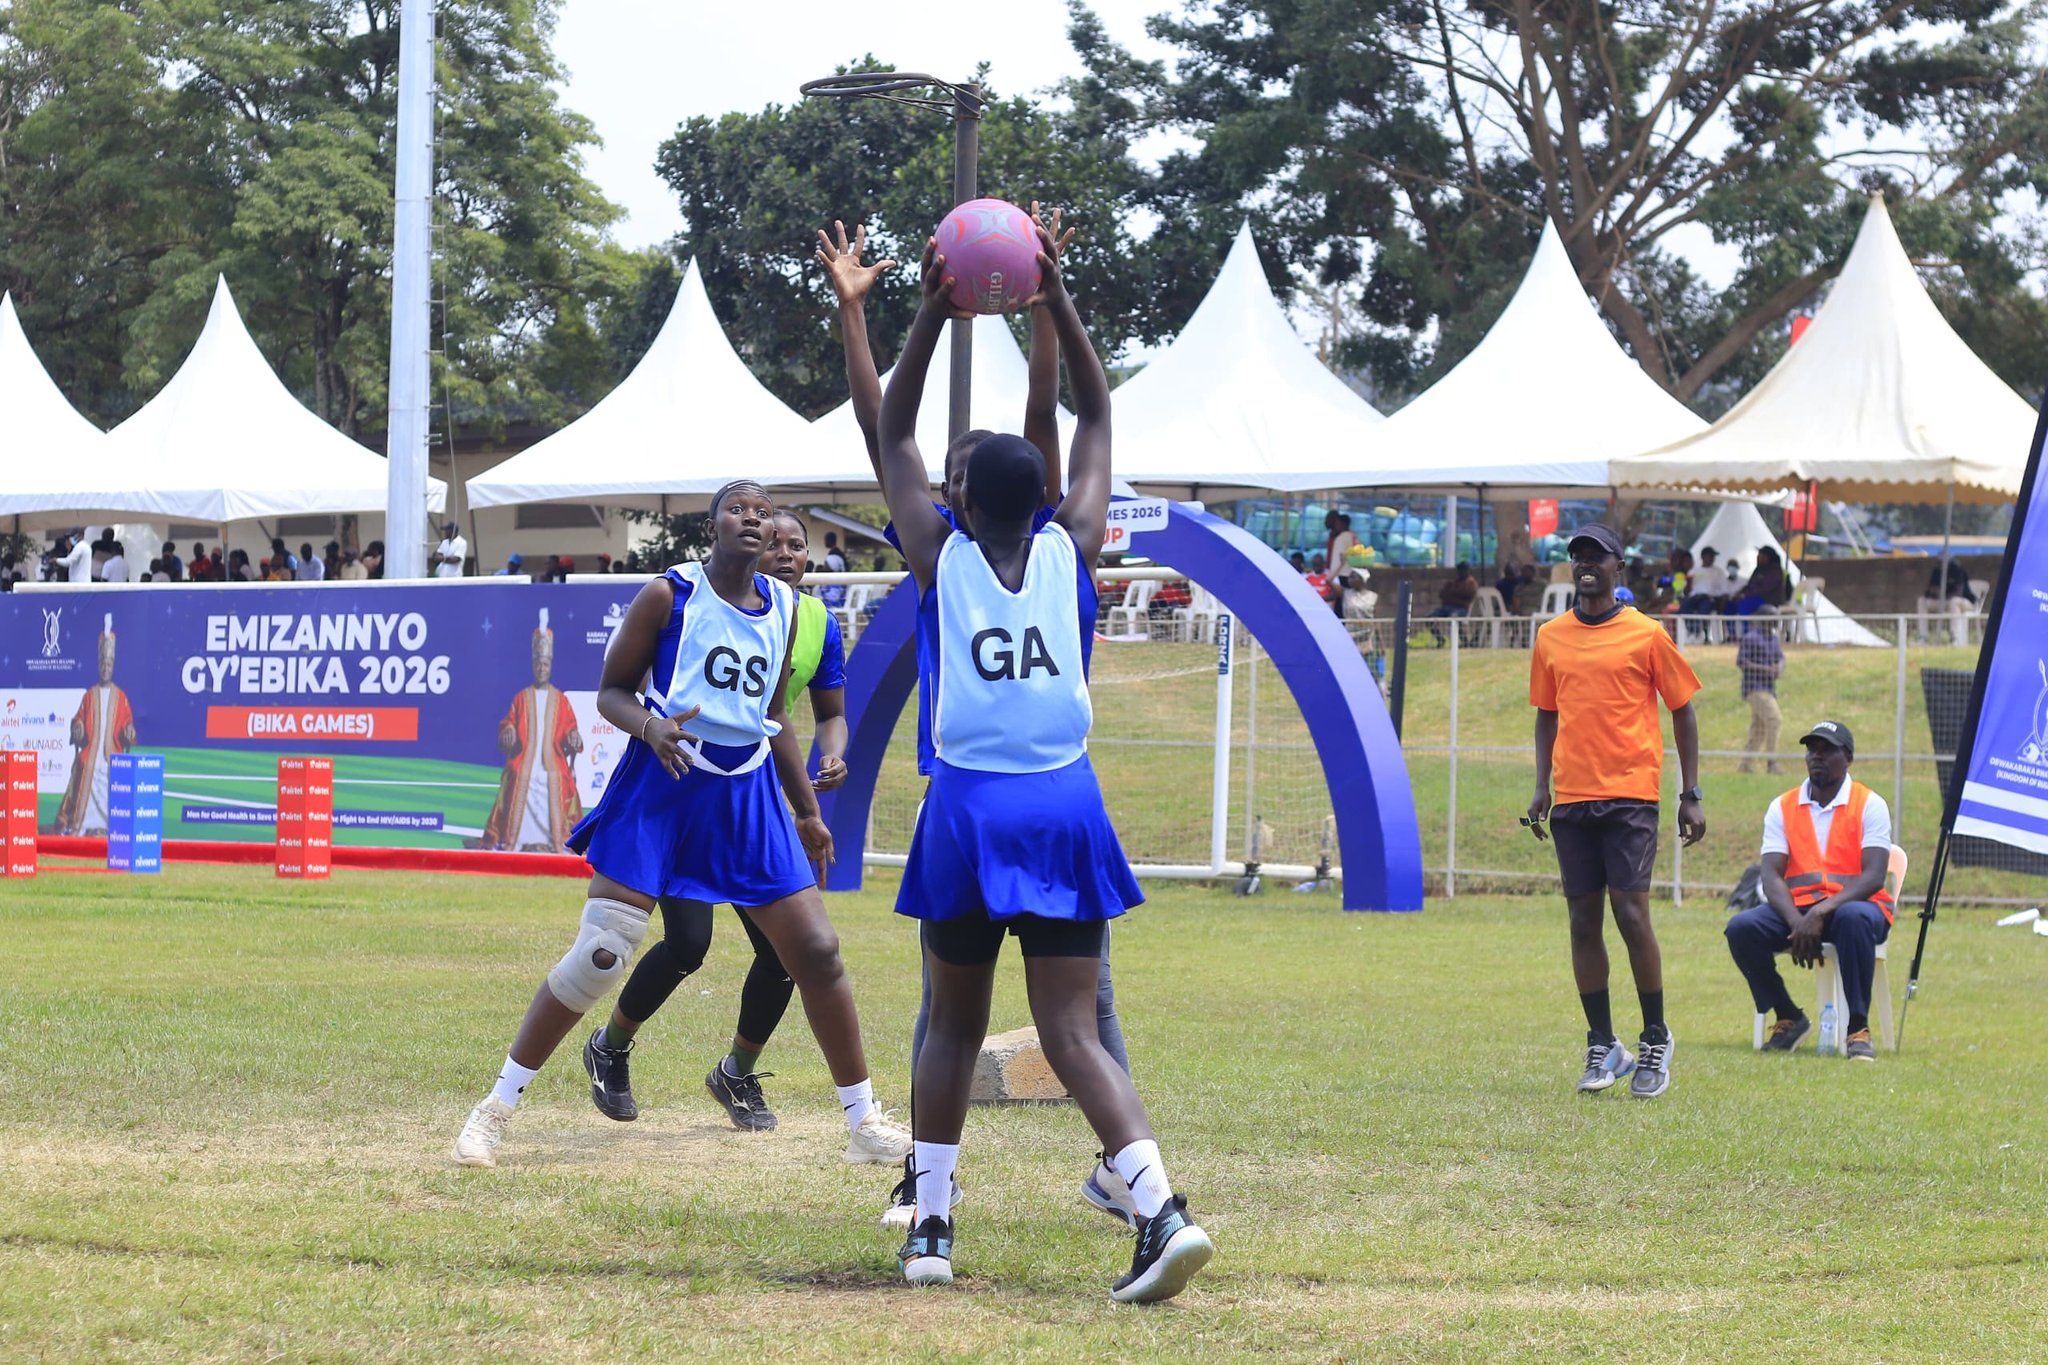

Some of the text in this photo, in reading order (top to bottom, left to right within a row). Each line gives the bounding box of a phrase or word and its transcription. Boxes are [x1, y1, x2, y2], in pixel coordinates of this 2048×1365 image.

[1106, 506, 1162, 521] MES 2026
[1103, 527, 1124, 545] UP
[206, 612, 427, 651] EMIZANNYO
[1219, 616, 1229, 665] FORZA
[970, 625, 1060, 682] GA
[181, 654, 451, 695] GY'EBIKA 2026
[704, 645, 768, 698] GS
[1, 716, 19, 727] airtel
[22, 713, 45, 726] nivana
[247, 712, 374, 738] (BIKA GAMES)
[591, 724, 614, 734] airtel
[32, 739, 63, 750] UNAIDS
[18, 753, 35, 763] airtel
[111, 757, 132, 768] nivana
[138, 757, 160, 768] nivana
[286, 761, 303, 769] airtel
[314, 761, 330, 769] airtel
[18, 782, 35, 790] airtel
[111, 782, 131, 792] nivana
[137, 782, 159, 792] nivana
[286, 786, 303, 795] airtel
[313, 786, 329, 795] airtel
[18, 809, 34, 818] airtel
[110, 806, 131, 817] nivana
[136, 806, 158, 817] nivana
[200, 810, 211, 819] for
[210, 810, 227, 819] Good
[227, 811, 248, 820] Health
[249, 812, 256, 820] to
[256, 812, 272, 821] Save
[286, 812, 302, 821] airtel
[313, 812, 328, 821] airtel
[340, 814, 357, 825] Fight
[358, 815, 366, 824] to
[366, 815, 379, 824] End
[380, 815, 411, 825] HIV/AIDS
[411, 816, 420, 827] by
[420, 817, 438, 826] 2030
[18, 837, 34, 845] airtel
[110, 831, 130, 842] nivana
[136, 831, 157, 842] nivana
[285, 839, 302, 847] airtel
[312, 838, 328, 847] airtel
[109, 856, 129, 867] nivana
[135, 856, 157, 867] nivana
[17, 864, 34, 873] airtel
[284, 865, 301, 873] airtel
[311, 864, 328, 873] airtel
